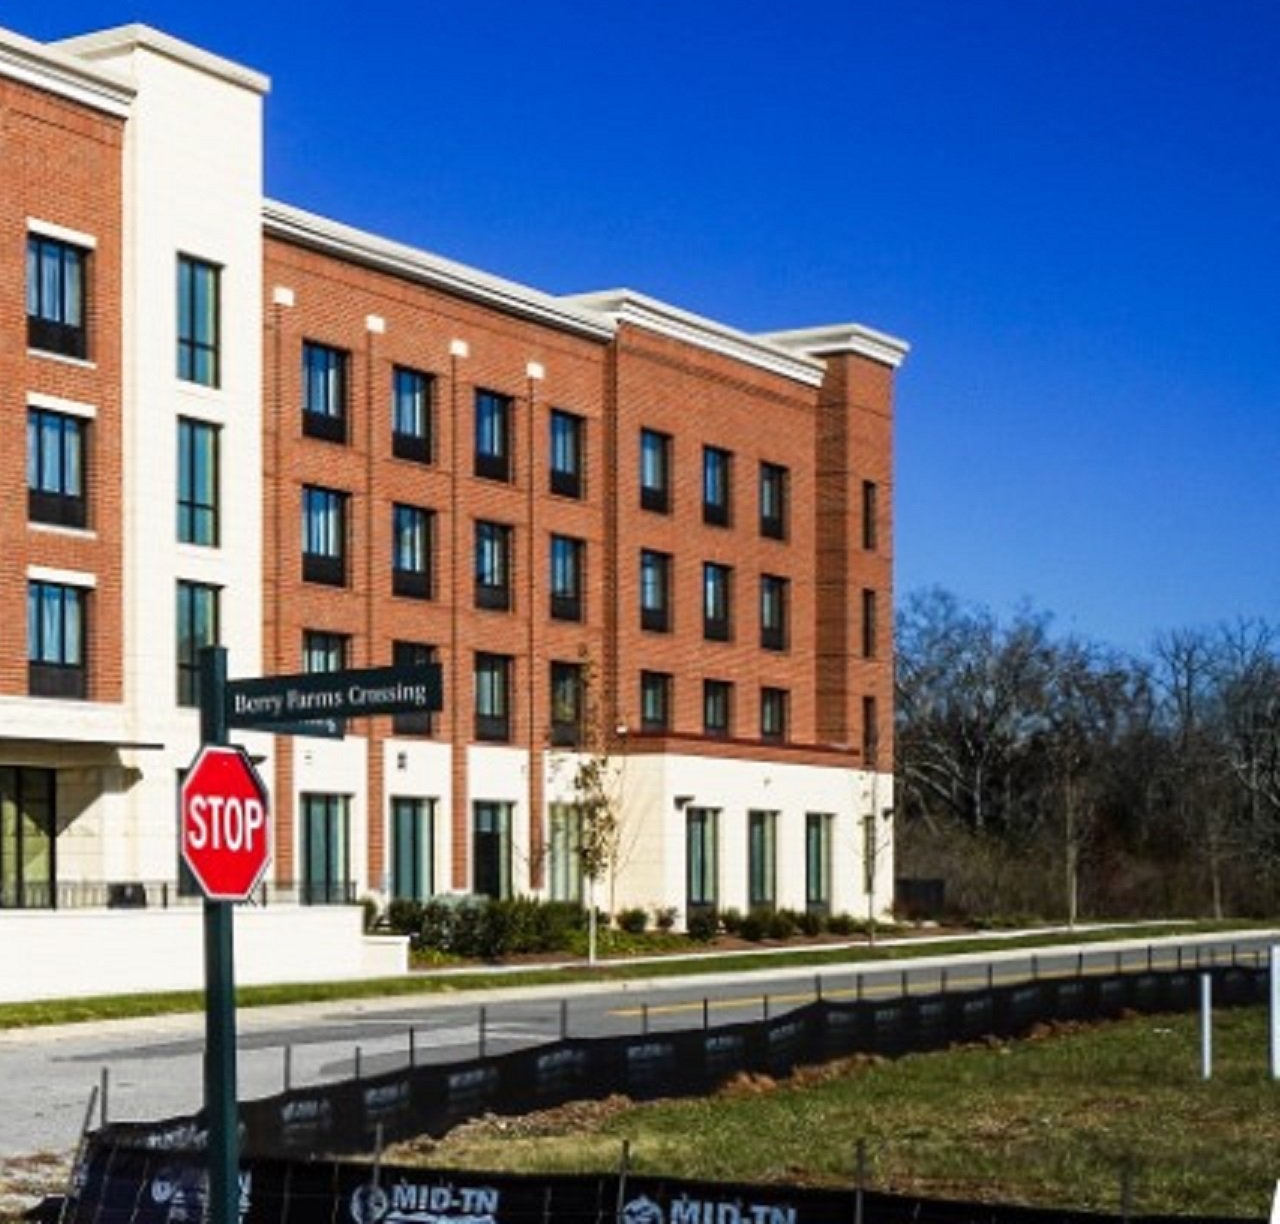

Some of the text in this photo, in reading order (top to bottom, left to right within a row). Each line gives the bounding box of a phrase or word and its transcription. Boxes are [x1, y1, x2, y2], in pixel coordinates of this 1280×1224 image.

[234, 681, 427, 717] Berry Farms Crossing
[188, 794, 264, 853] STOP
[391, 1183, 499, 1214] MID-TN
[670, 1198, 798, 1224] MID-TN
